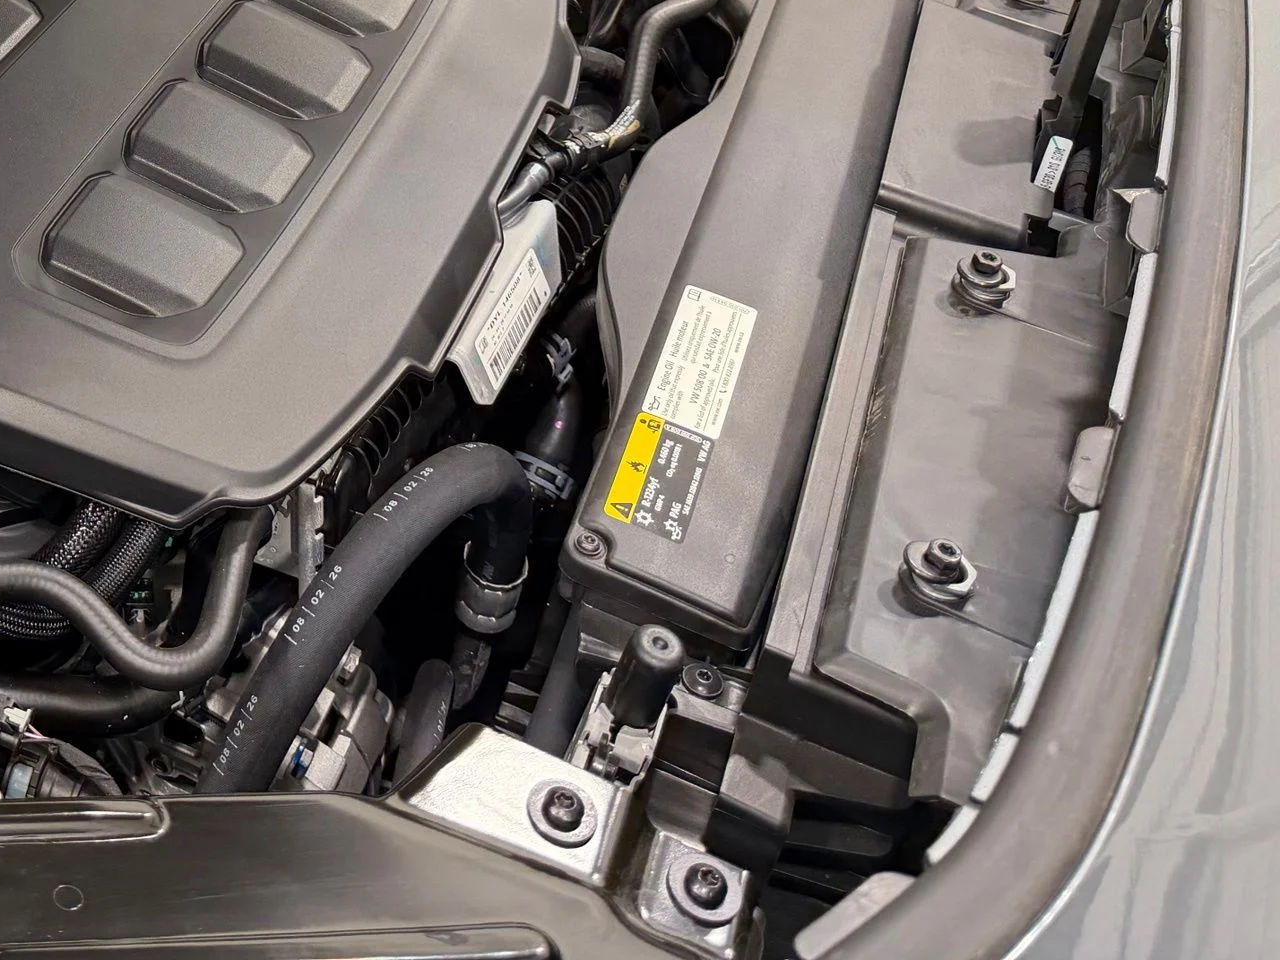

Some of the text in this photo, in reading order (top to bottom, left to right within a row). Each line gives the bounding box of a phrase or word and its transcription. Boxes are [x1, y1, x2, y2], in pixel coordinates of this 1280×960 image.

[670, 320, 687, 357] Huile moteur
[708, 327, 721, 348] 0W-20
[704, 348, 713, 360] SAE
[658, 359, 673, 391] Engine Oil
[697, 369, 706, 379] 00
[693, 379, 704, 392] 508
[689, 392, 699, 404] VW
[701, 439, 710, 450] AG
[697, 449, 707, 462] VW
[641, 476, 659, 507] R-1234yf
[663, 438, 673, 448] kg
[669, 501, 681, 518] PAG
[292, 565, 343, 633] 08 02 26
[233, 720, 245, 736] 02
[246, 695, 259, 711] 26
